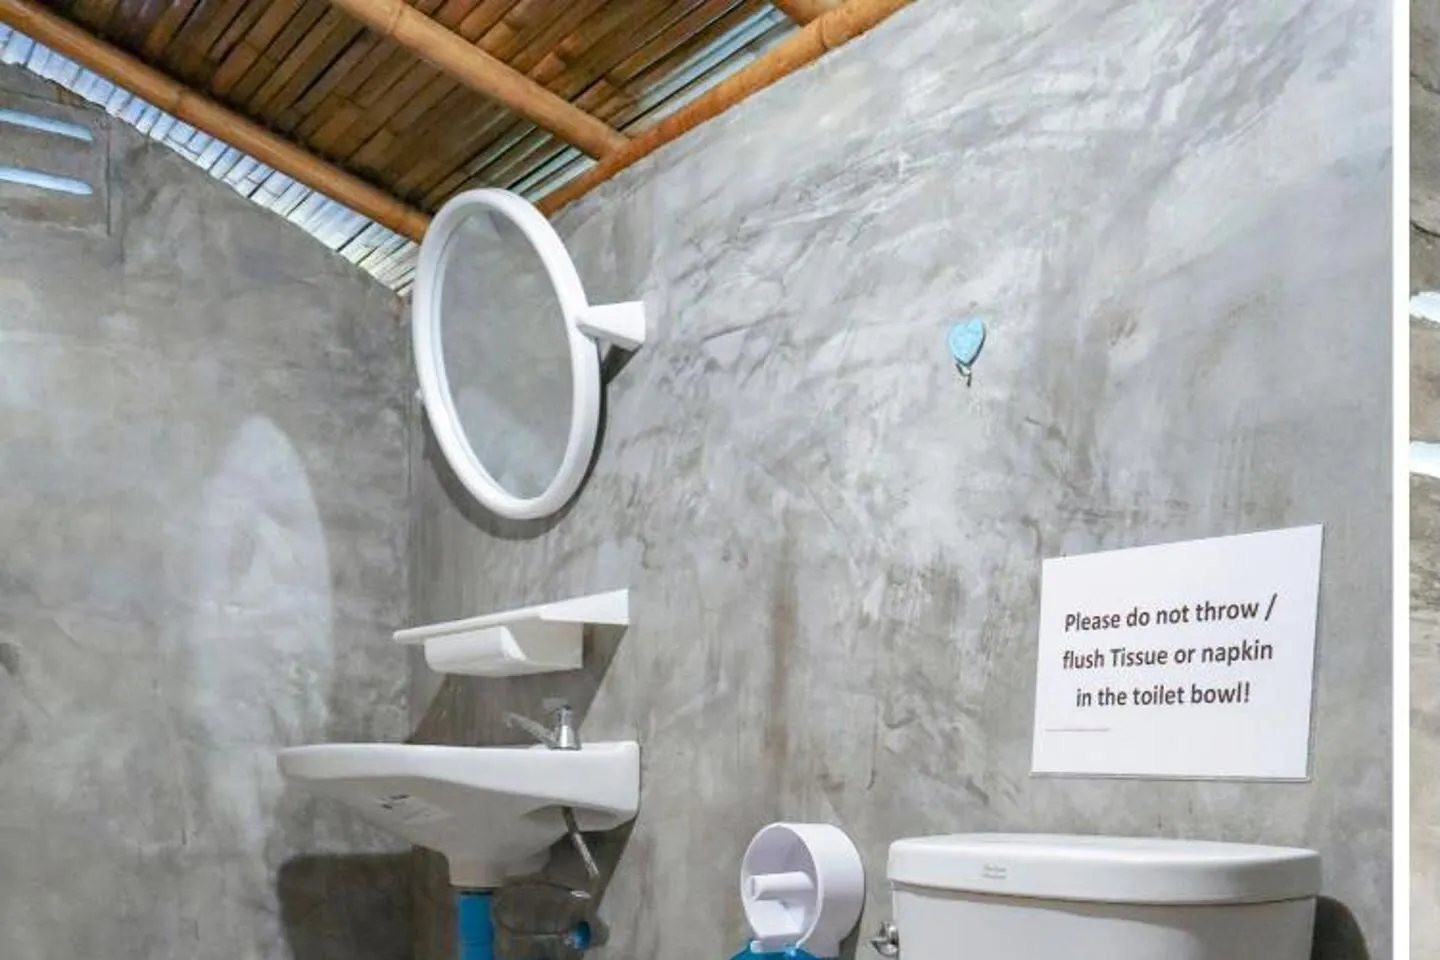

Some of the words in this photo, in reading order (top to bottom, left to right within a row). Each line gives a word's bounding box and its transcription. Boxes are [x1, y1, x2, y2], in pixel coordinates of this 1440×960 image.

[1064, 612, 1121, 632] Please
[1126, 607, 1150, 627] do
[1155, 605, 1190, 624] not
[1195, 600, 1259, 622] throw
[1264, 593, 1278, 621] /
[1063, 649, 1104, 669] flush
[1110, 647, 1168, 668] Tissue
[1174, 648, 1194, 664] or
[1201, 639, 1273, 667] napkin
[1076, 688, 1091, 707] in
[1097, 687, 1127, 706] the
[1133, 685, 1184, 706] toilet
[1190, 682, 1250, 704] bowl!
